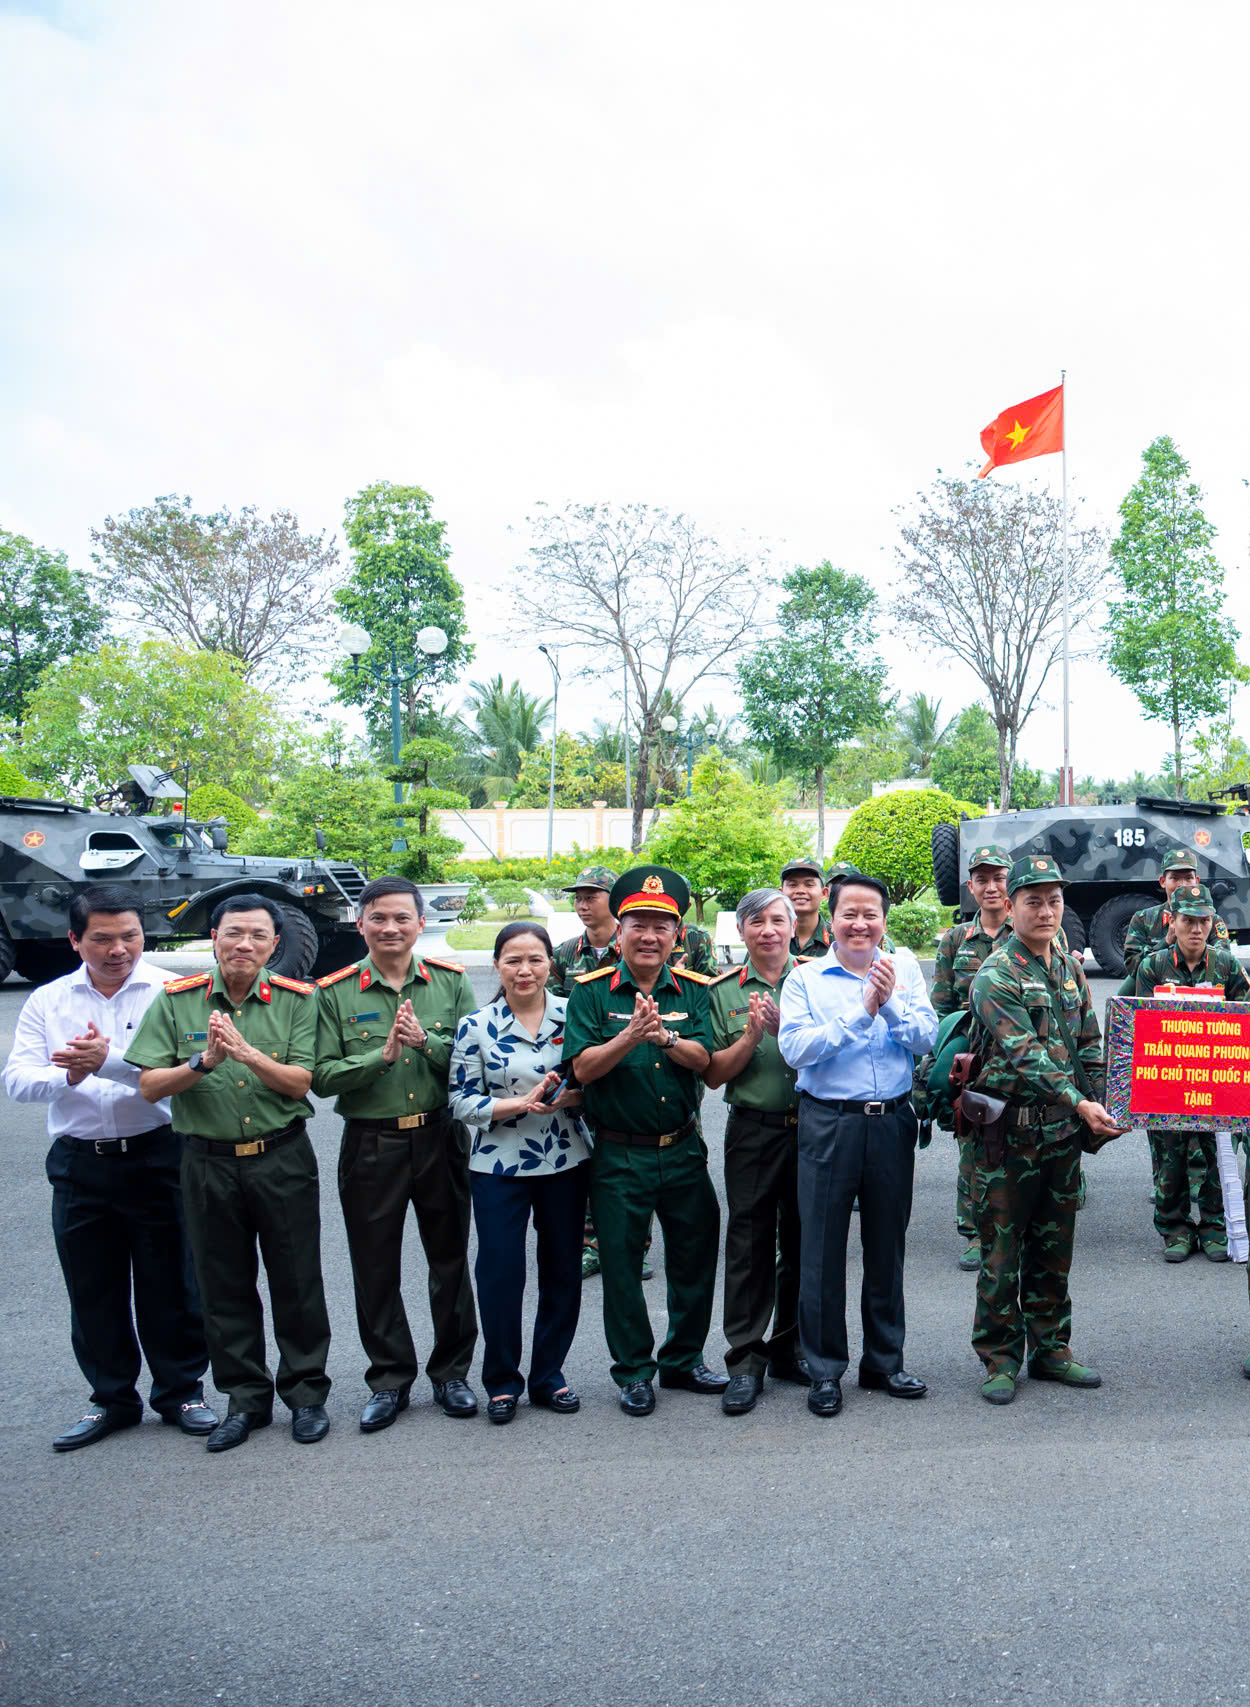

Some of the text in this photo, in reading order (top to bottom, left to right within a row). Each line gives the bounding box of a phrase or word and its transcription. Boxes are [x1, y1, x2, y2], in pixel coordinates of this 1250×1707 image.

[1114, 828, 1146, 847] 185
[1161, 1020, 1241, 1036] THƯỢNG TƯỚNG
[1174, 1044, 1210, 1059] QUANG
[1136, 1065, 1158, 1080] PHÓ
[1161, 1064, 1183, 1081] CHỦ
[1186, 1068, 1209, 1084] TỊCH
[1212, 1066, 1241, 1084] QUỐC
[1184, 1090, 1212, 1108] TẶNG
